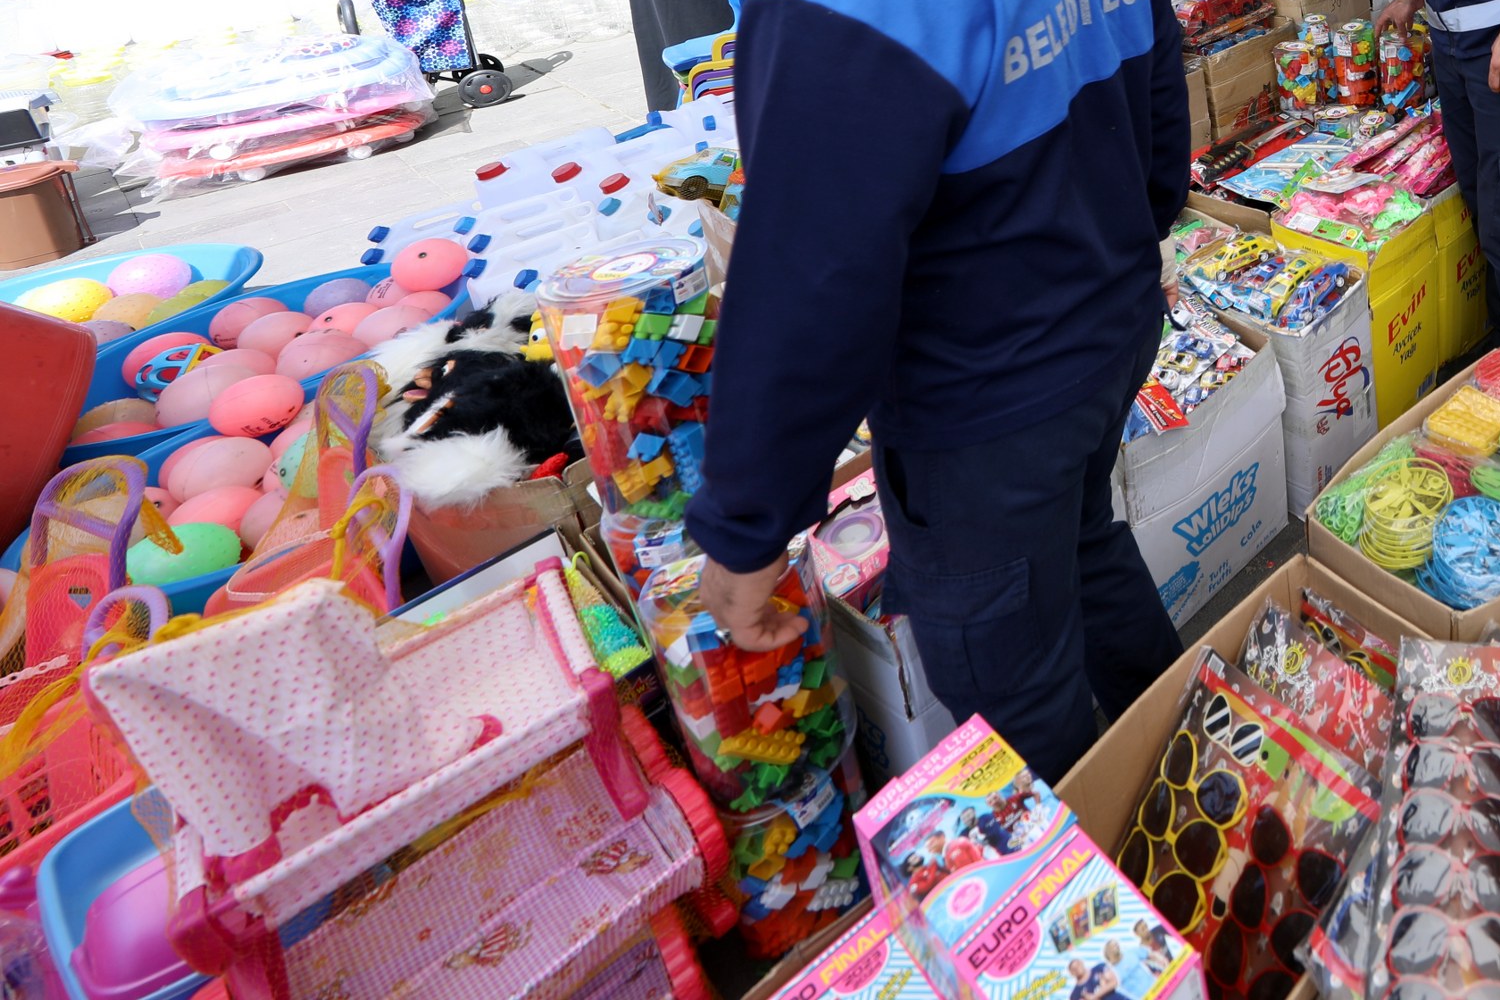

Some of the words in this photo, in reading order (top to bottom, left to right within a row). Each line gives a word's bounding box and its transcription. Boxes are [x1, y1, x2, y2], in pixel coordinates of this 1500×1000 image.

[1388, 281, 1427, 346] Evin
[1240, 520, 1262, 546] Cola
[1209, 560, 1229, 582] Tutti
[1209, 568, 1231, 593] Frutti
[968, 905, 1029, 969] EURO
[1028, 848, 1092, 908] FİNAL
[819, 928, 888, 985] FİNAL
